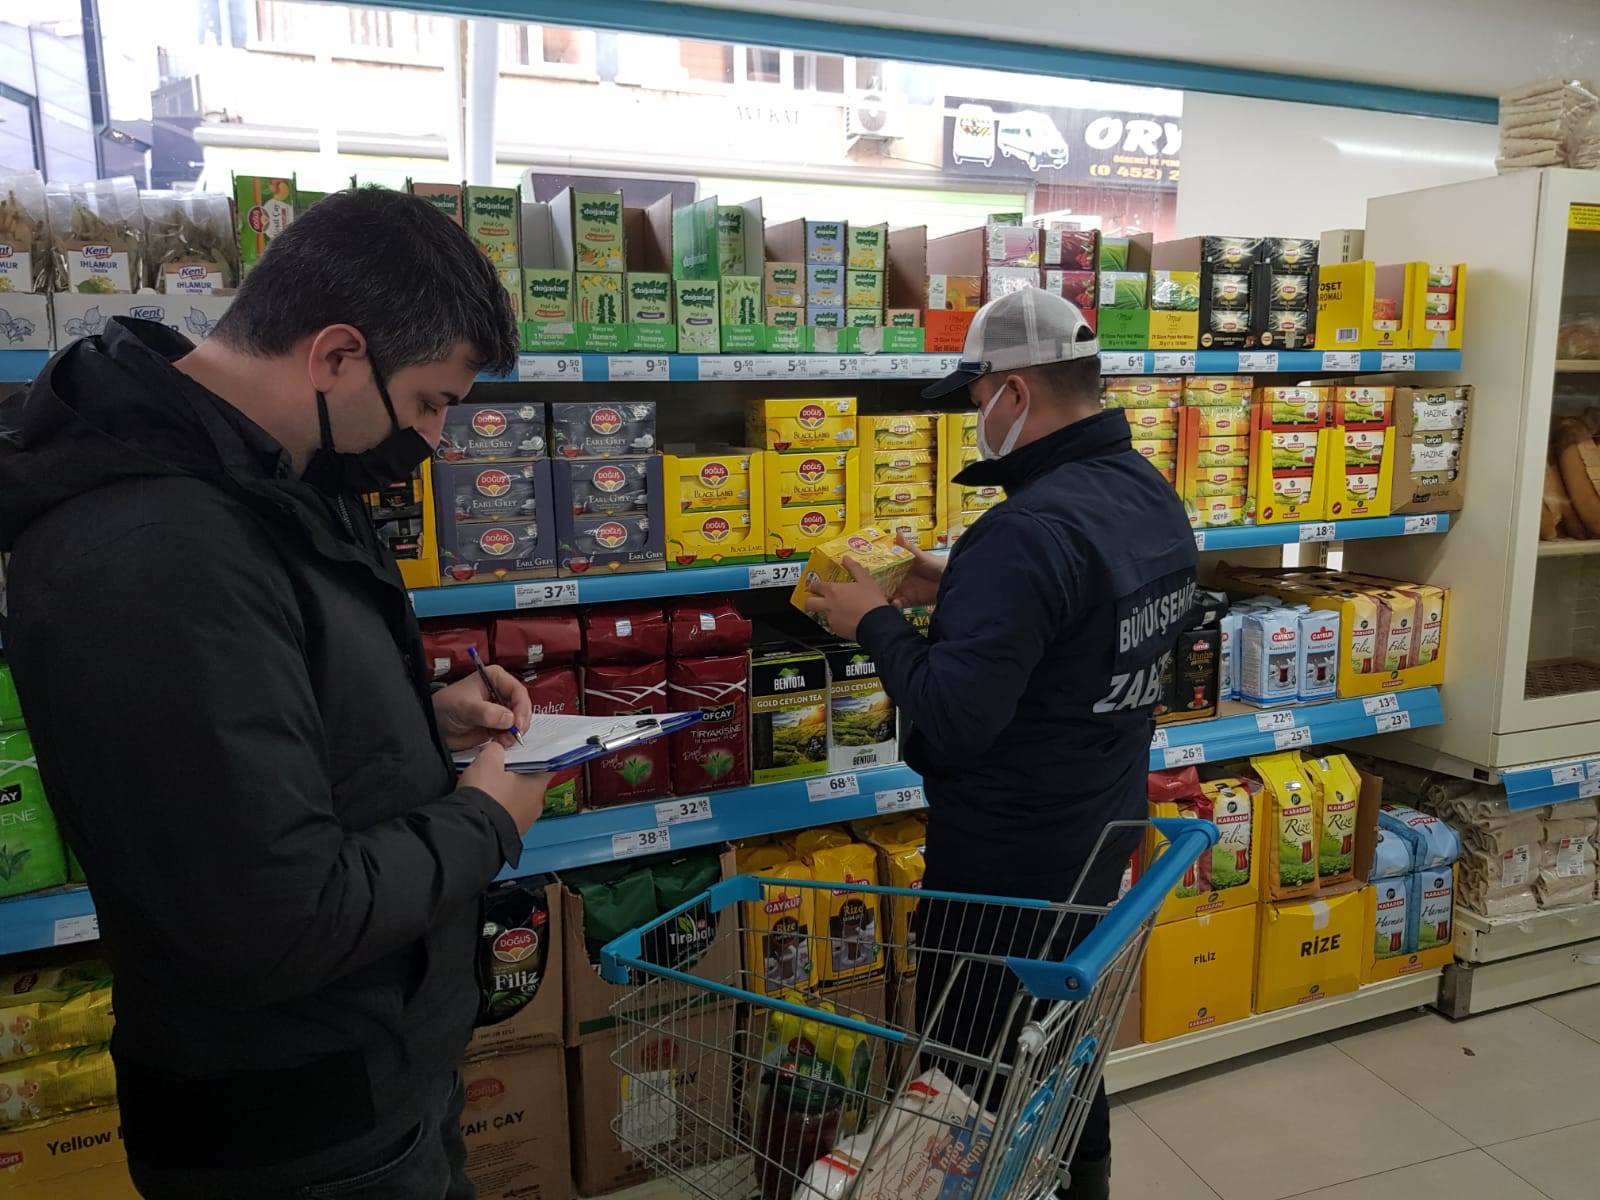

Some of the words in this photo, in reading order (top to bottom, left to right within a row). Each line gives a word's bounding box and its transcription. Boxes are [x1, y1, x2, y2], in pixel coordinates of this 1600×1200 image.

[1168, 169, 1180, 181] 2
[476, 202, 511, 212] doğadan
[583, 208, 617, 218] doğadan
[86, 246, 109, 256] Kent
[181, 267, 205, 276] Kent
[533, 284, 567, 295] doğadan
[635, 285, 667, 297] doğadan
[684, 294, 714, 303] doğadan
[134, 309, 161, 319] Kent
[477, 414, 501, 425] DOĞUŞ
[594, 412, 618, 423] DOĞUŞ
[802, 409, 823, 419] DOĞUŞ
[704, 466, 725, 477] DOĞUŞ
[802, 463, 823, 473] DOĞUŞ
[481, 474, 505, 485] DOĞUŞ
[598, 471, 622, 481] DOĞUŞ
[705, 520, 727, 532] DOĞUŞ
[803, 515, 824, 526] DOĞUŞ
[485, 533, 510, 544] DOĞUŞ
[600, 527, 623, 538] DOĞUŞ
[846, 663, 877, 678] BENTOTA
[774, 676, 806, 692] BENTOTA
[851, 682, 878, 693] CEYLON
[757, 698, 778, 709] GOLD
[779, 694, 809, 705] CEYLON
[533, 701, 565, 715] Bahçe
[702, 709, 732, 721] OFÇAY
[853, 754, 877, 766] BENTOTA
[0, 791, 19, 803] AY
[2, 808, 38, 826] ENE
[1327, 814, 1353, 830] Rize
[1284, 818, 1312, 837] Rize
[1220, 824, 1247, 846] Filiz
[500, 934, 531, 948] DOĞUŞ
[1300, 934, 1341, 957] RİZE
[1193, 952, 1216, 965] FİLİZ
[493, 970, 540, 991] Filiz
[47, 1131, 112, 1156] Yellow
